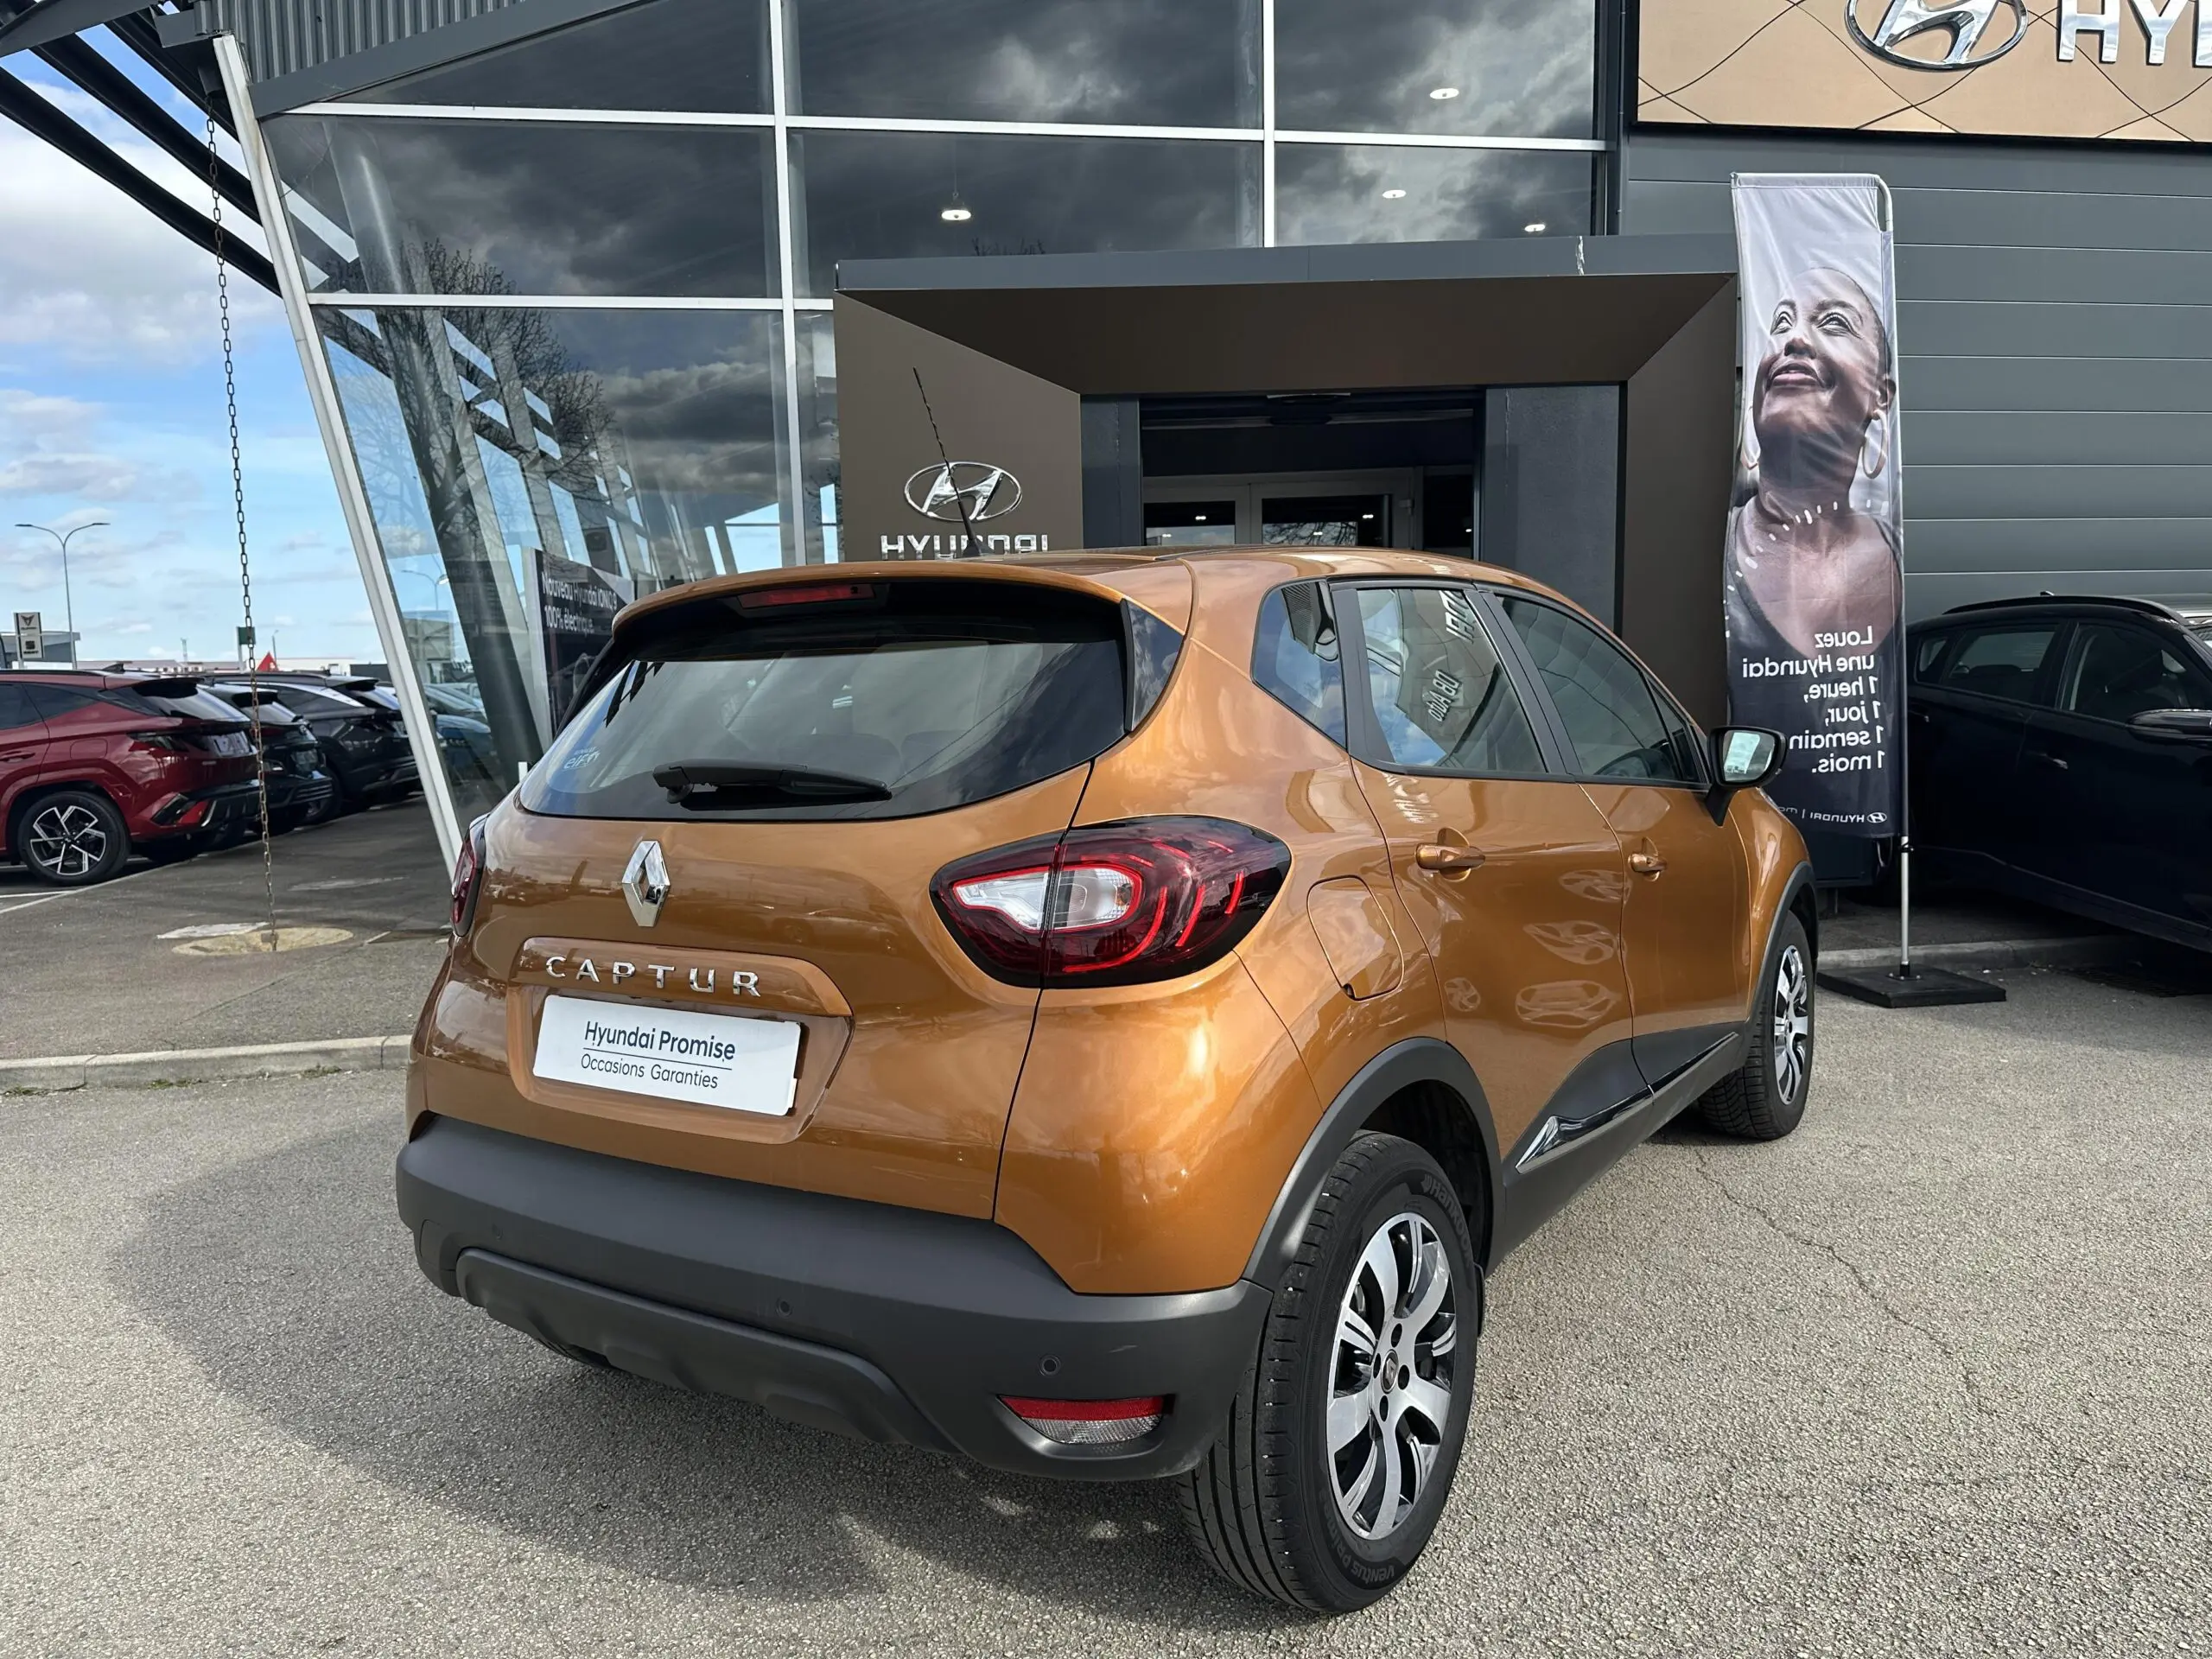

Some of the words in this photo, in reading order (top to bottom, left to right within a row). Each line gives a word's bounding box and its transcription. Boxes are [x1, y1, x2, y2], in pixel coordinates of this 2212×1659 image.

[542, 571, 573, 601] Nouveau
[544, 605, 564, 630] 100%
[545, 956, 761, 998] CAPTUR
[584, 1020, 655, 1051] Hyundai
[658, 1031, 736, 1062] Promise
[581, 1052, 645, 1078] Occasions
[650, 1065, 719, 1090] Garanties
